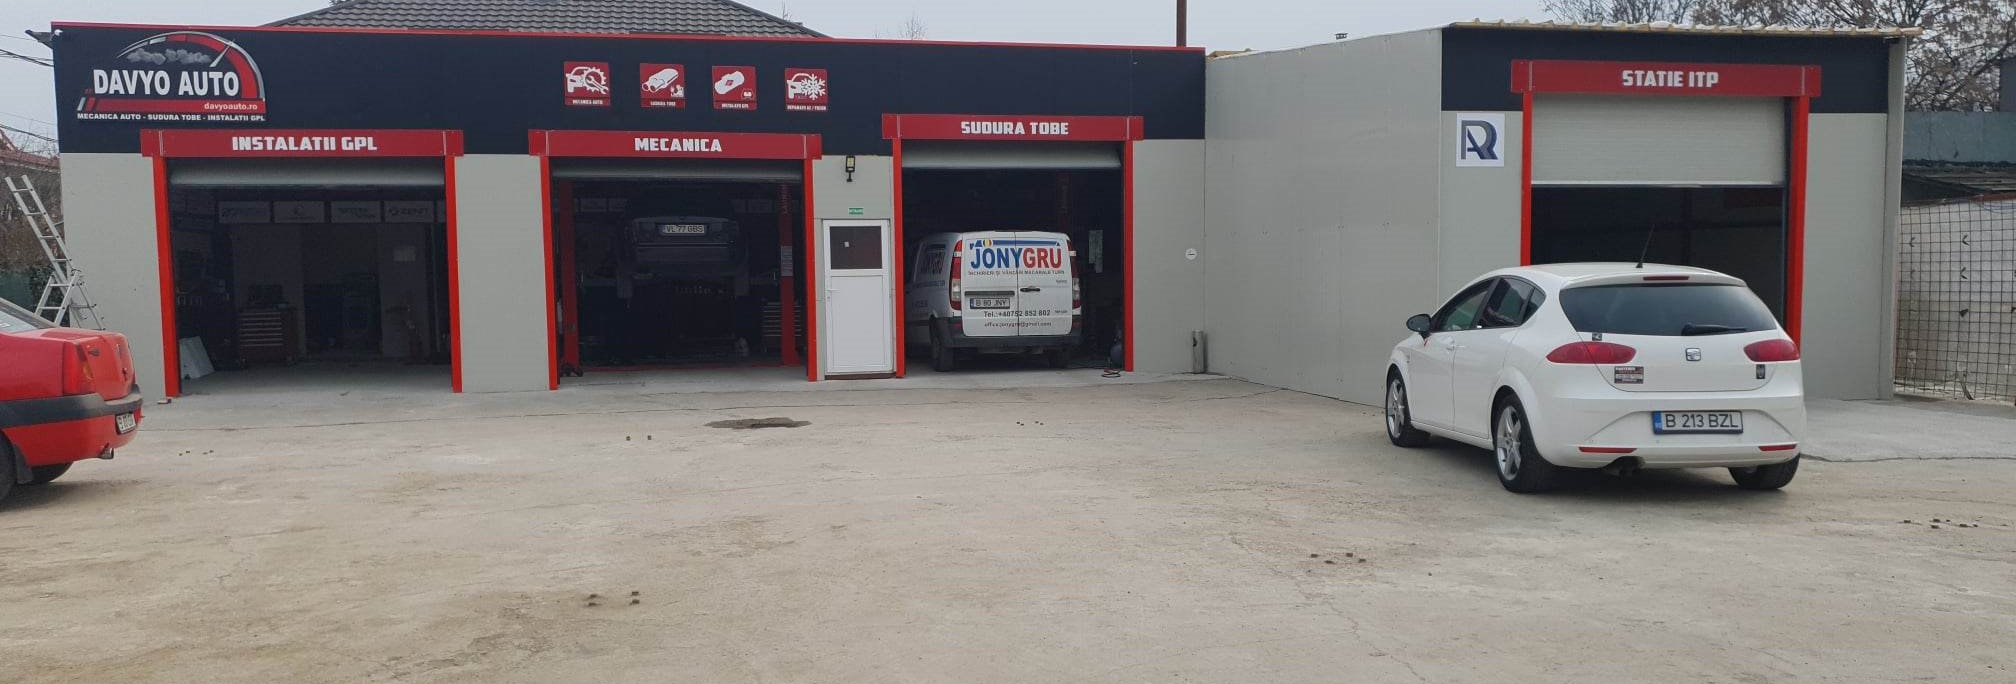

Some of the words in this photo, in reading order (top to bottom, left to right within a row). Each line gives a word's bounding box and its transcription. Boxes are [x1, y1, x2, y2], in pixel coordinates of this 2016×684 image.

[93, 69, 170, 95] DAVYO
[178, 71, 239, 96] AUTO
[1622, 70, 1683, 87] STATIE
[1689, 71, 1719, 87] ITP
[204, 102, 258, 111] davyoauto.ro
[961, 121, 1025, 134] SUDURA
[1030, 122, 1069, 135] TOBE
[232, 136, 336, 150] INSTALATII
[341, 136, 377, 150] GPL
[634, 138, 722, 152] MECANICA
[970, 248, 1062, 269] JONYGRU
[1665, 414, 1677, 427] B
[1682, 414, 1704, 427] 213
[1708, 413, 1739, 427] BZL
